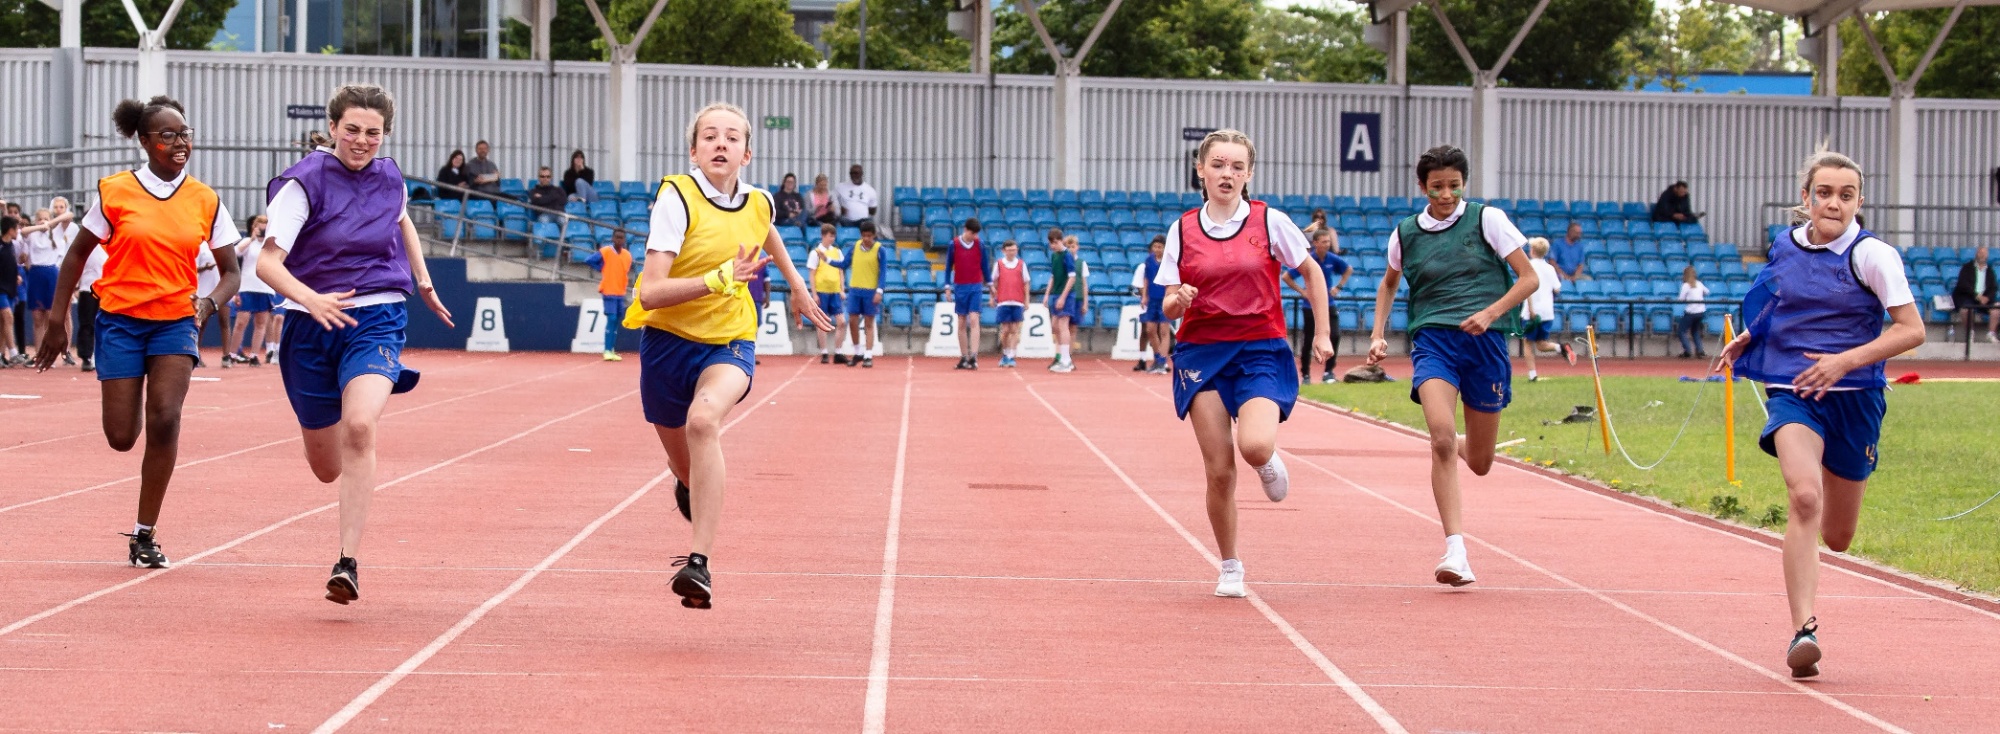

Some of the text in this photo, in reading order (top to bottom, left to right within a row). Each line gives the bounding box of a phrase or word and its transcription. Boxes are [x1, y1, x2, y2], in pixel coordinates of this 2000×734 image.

[1346, 123, 1374, 161] A
[481, 309, 495, 331] 8
[586, 310, 599, 333] 7
[765, 312, 778, 335] 5
[940, 314, 954, 336] 3
[1029, 314, 1044, 337] 2
[1129, 317, 1138, 340] 1
